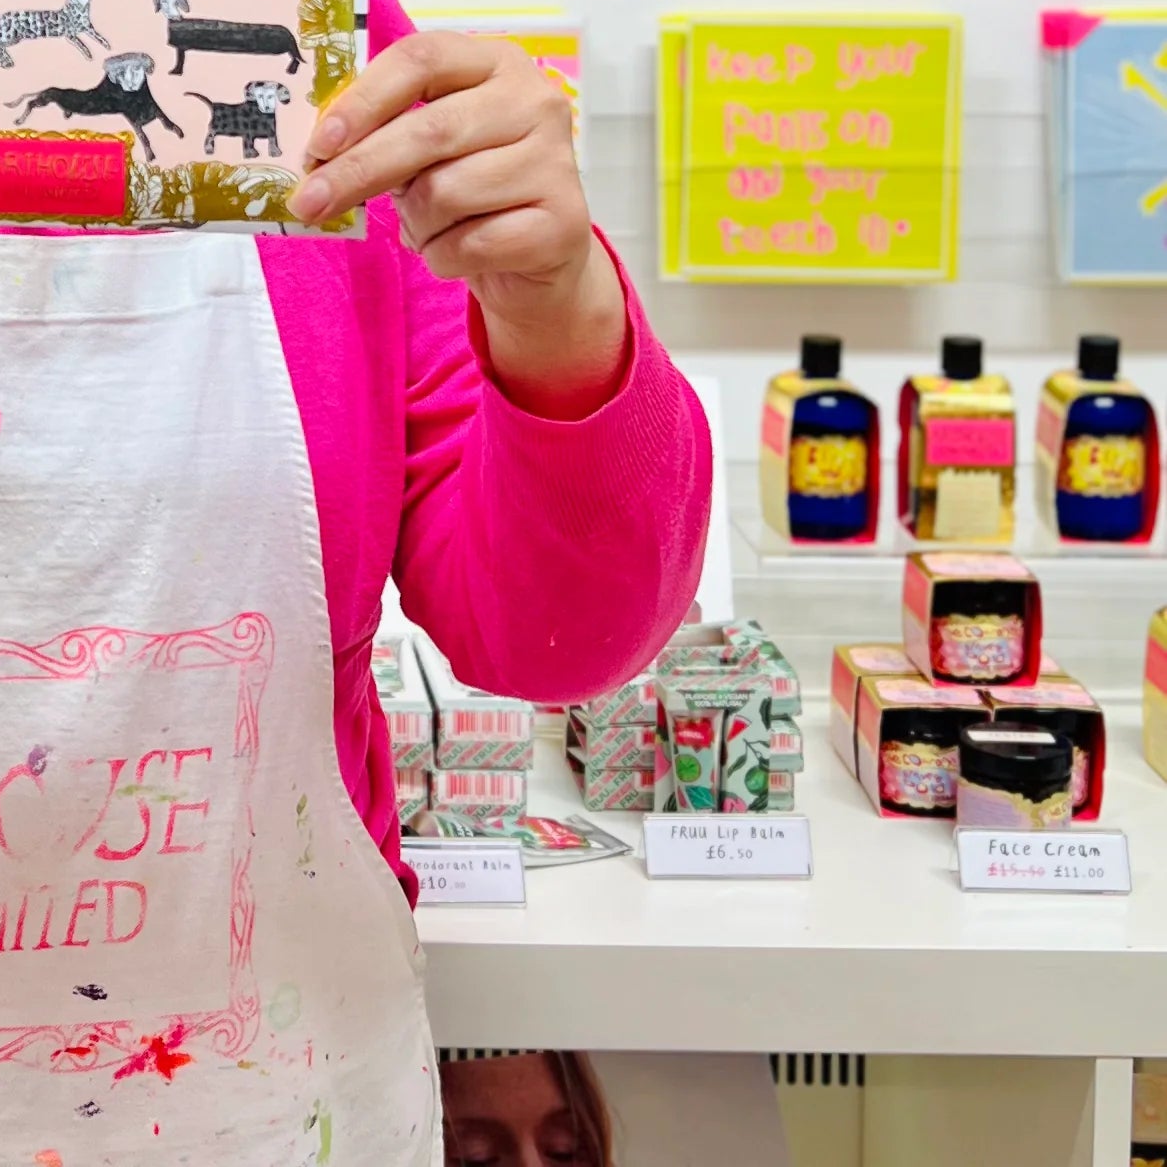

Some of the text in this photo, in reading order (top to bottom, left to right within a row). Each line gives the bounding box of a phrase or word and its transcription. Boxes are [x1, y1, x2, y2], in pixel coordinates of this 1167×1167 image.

[671, 826, 785, 841] FRUU Lip Balm
[706, 845, 753, 860] £6.50
[988, 839, 1101, 857] Face Cream
[1054, 865, 1105, 878] £11.00
